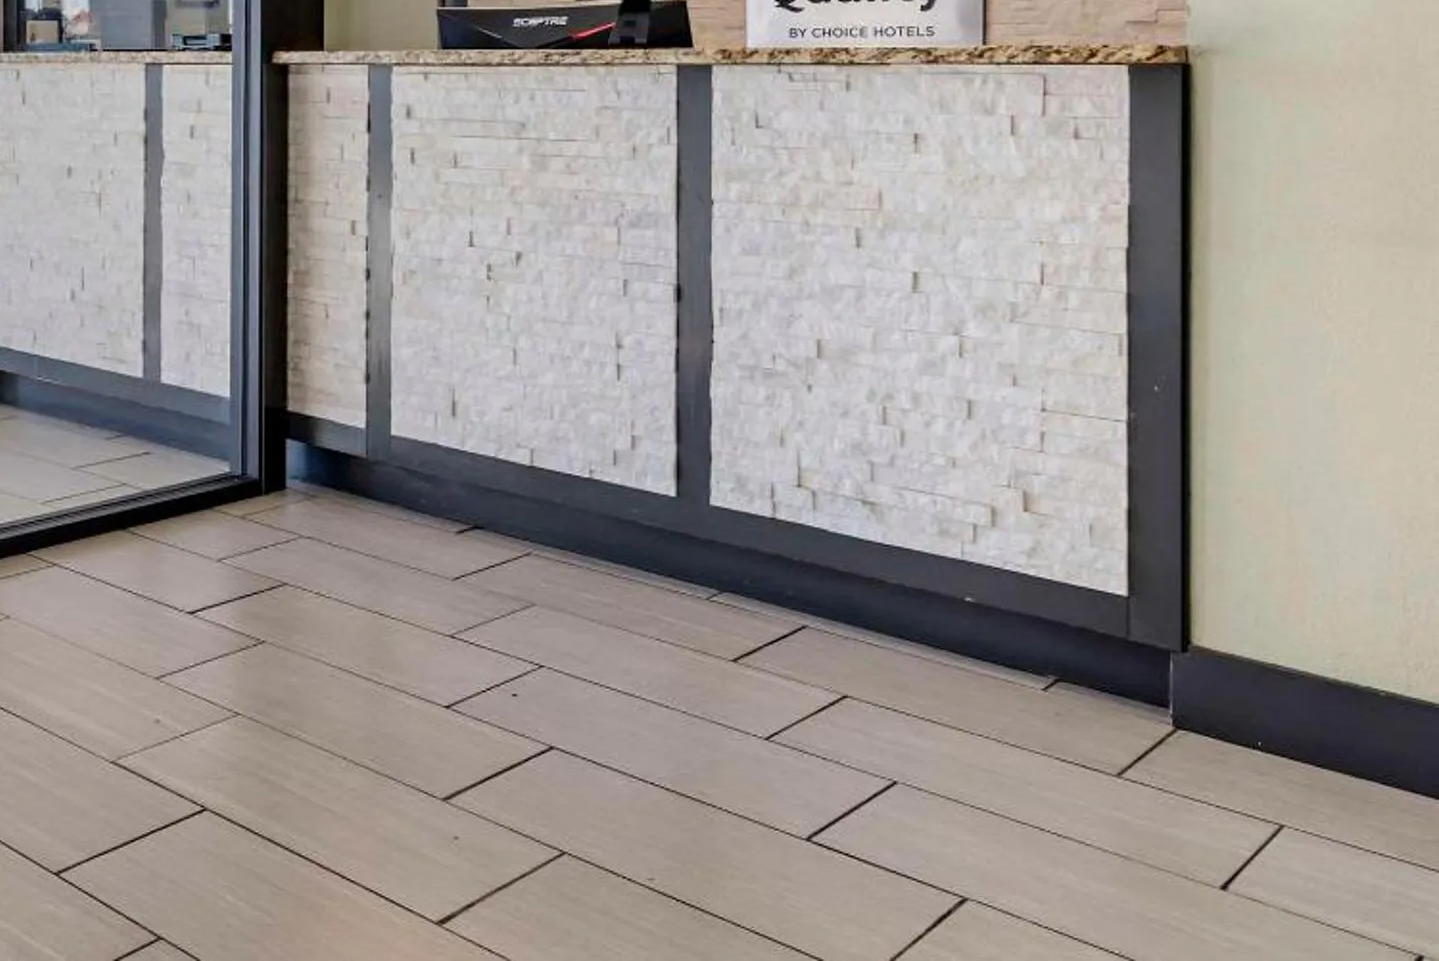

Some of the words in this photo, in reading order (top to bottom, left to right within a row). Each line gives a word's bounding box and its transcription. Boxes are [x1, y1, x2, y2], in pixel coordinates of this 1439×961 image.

[789, 27, 807, 38] BY
[811, 26, 869, 38] CHOICE
[874, 25, 935, 37] HOTELS
